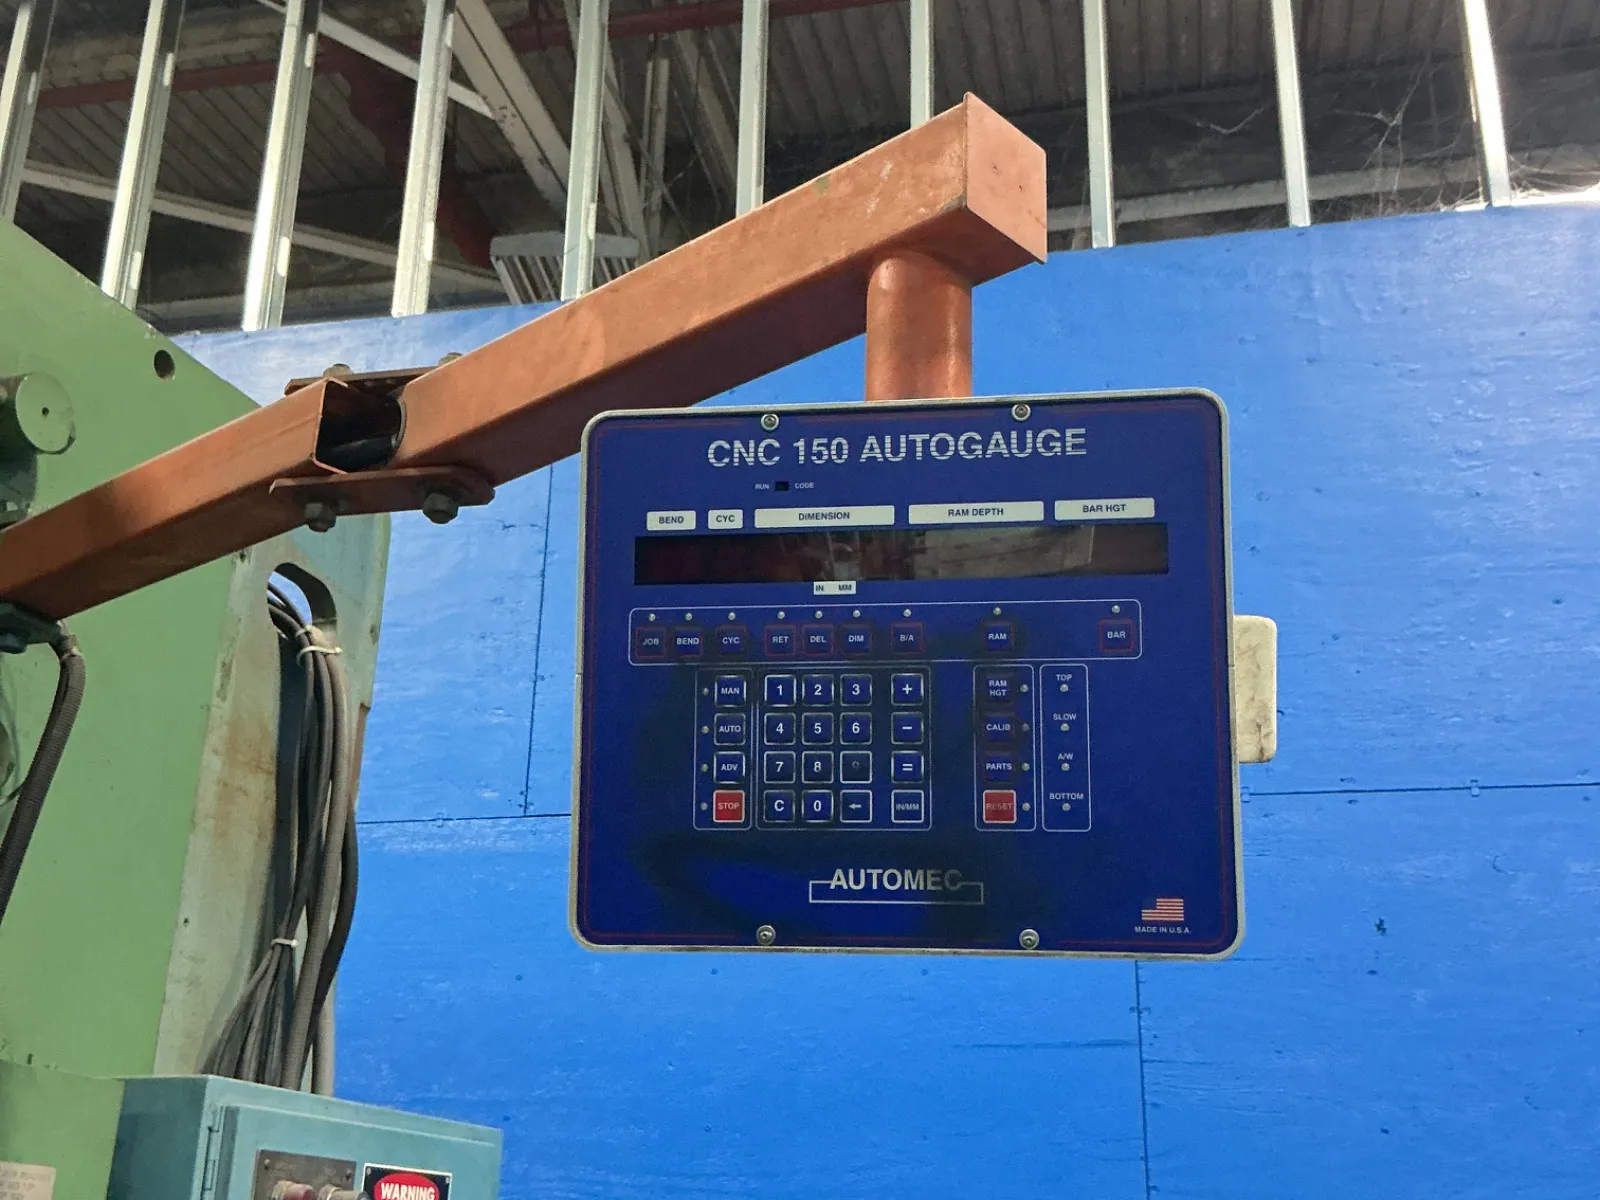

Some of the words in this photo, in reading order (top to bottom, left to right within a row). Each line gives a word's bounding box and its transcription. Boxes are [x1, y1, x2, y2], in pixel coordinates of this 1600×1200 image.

[707, 438, 781, 468] CNC
[793, 436, 849, 465] 150
[859, 428, 1087, 463] AUTOGAUGE
[794, 481, 814, 490] CODE
[947, 508, 970, 517] RAM
[972, 507, 1004, 517] DEPTH
[1082, 504, 1104, 513] BAR
[1105, 503, 1127, 513] HGT
[658, 515, 684, 525] BEND
[715, 514, 736, 524] CYC
[798, 511, 851, 521] DIMENSION
[815, 584, 825, 592] IN
[772, 635, 789, 644] RET
[810, 635, 827, 643] DEL
[899, 634, 914, 642] B/A
[1107, 631, 1126, 639] BAR
[642, 637, 660, 645] JOB
[676, 637, 700, 645] BEND
[722, 636, 740, 645] CYC
[721, 687, 740, 695] MAN
[776, 684, 783, 696] 1
[814, 684, 822, 696] 2
[852, 684, 860, 695] 3
[1053, 713, 1077, 721] SLOW
[718, 725, 741, 733] AUTO
[776, 723, 784, 734] 4
[814, 723, 822, 734] 5
[852, 722, 860, 734] 6
[986, 723, 1011, 731] CALIB
[1057, 753, 1074, 761] A/W
[720, 763, 738, 771] ADV
[775, 761, 784, 772] 7
[813, 761, 822, 773] 8
[986, 763, 1013, 771] PARTS
[717, 802, 740, 810] STOP
[774, 800, 785, 812] C
[813, 800, 822, 812] 0
[829, 868, 963, 891] AUTOMEC
[381, 1182, 436, 1200] WARNING
